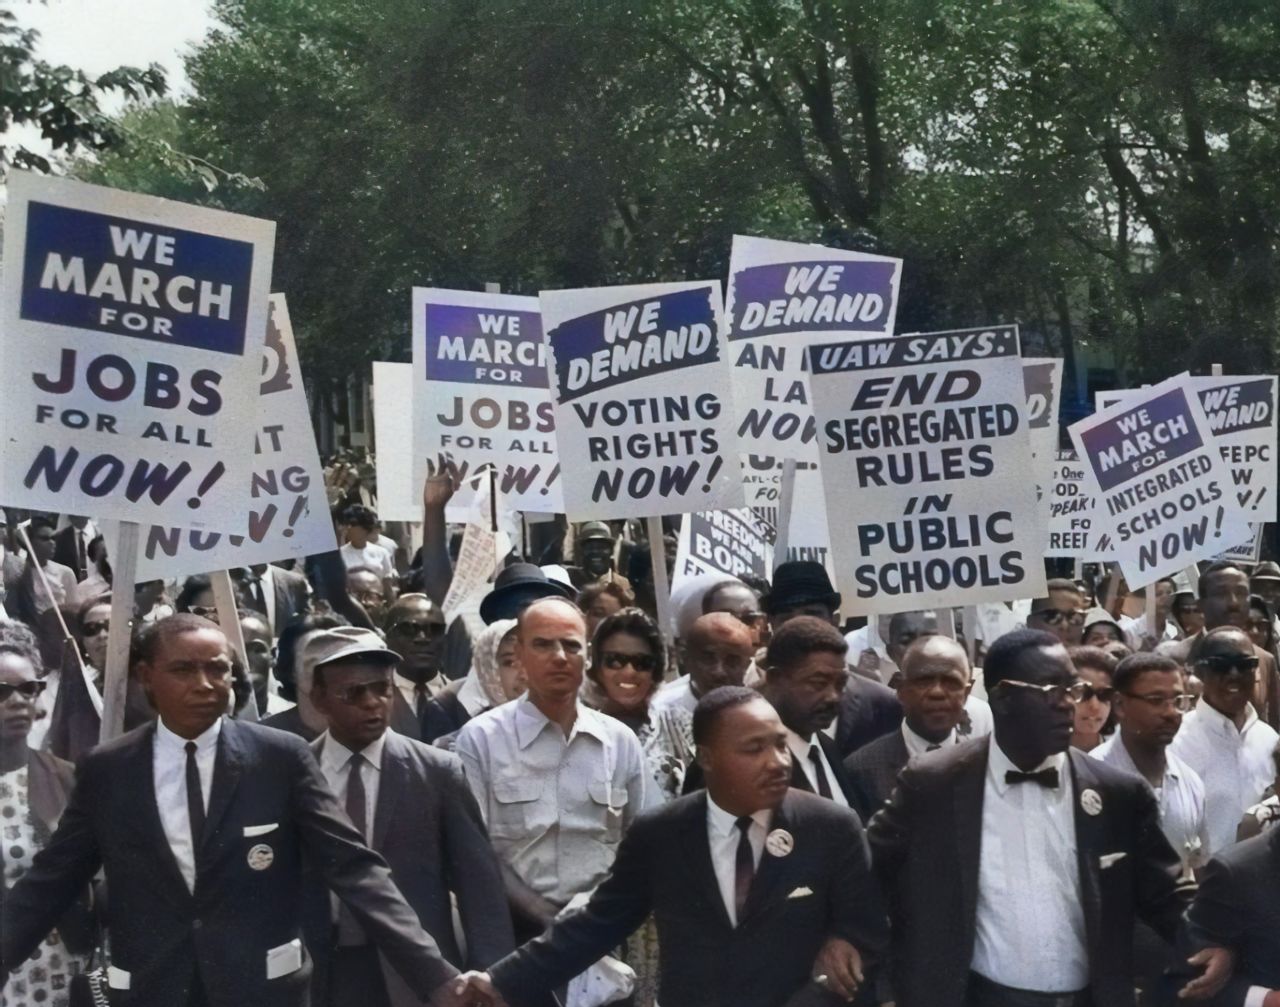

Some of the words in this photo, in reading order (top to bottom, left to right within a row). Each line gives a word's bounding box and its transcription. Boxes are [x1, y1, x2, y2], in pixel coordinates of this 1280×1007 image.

[109, 225, 175, 266] WE
[39, 252, 233, 321] MARCH
[784, 264, 845, 296] WE
[100, 307, 173, 337] FOR
[478, 313, 520, 336] WE
[604, 301, 661, 344] WE
[740, 293, 884, 332] DEMAND
[567, 323, 712, 391] DEMAND
[735, 343, 786, 371] AN
[819, 342, 896, 370] UAW
[903, 330, 1012, 363] SAYS:
[32, 348, 223, 416] JOBS
[475, 367, 522, 383] FOR
[851, 369, 982, 411] END
[436, 396, 556, 434] JOBS
[573, 393, 721, 428] VOTING
[1203, 386, 1241, 412] WE
[35, 404, 119, 434] FOR
[141, 421, 213, 448] ALL
[824, 403, 1019, 454] SEGREGATED
[1116, 408, 1152, 435] WE
[440, 434, 492, 450] FOR
[508, 439, 553, 454] ALL
[589, 428, 718, 462] RIGHTS
[1098, 415, 1189, 473] MARCH
[1132, 450, 1168, 473] FOR
[1219, 445, 1270, 464] FEPC
[23, 445, 226, 509] NOW!
[592, 454, 723, 503] NOW!
[856, 444, 994, 488] RULES
[1105, 454, 1212, 517] INTEGRATED
[755, 487, 780, 501] FO
[903, 494, 952, 515] IN
[1050, 497, 1089, 517] PEAK
[1055, 483, 1079, 496] OD
[1117, 481, 1222, 542] SCHOOLS
[857, 511, 1014, 556] PUBLIC
[1139, 505, 1224, 572] NOW!
[855, 550, 1025, 598] SCHOOLS
